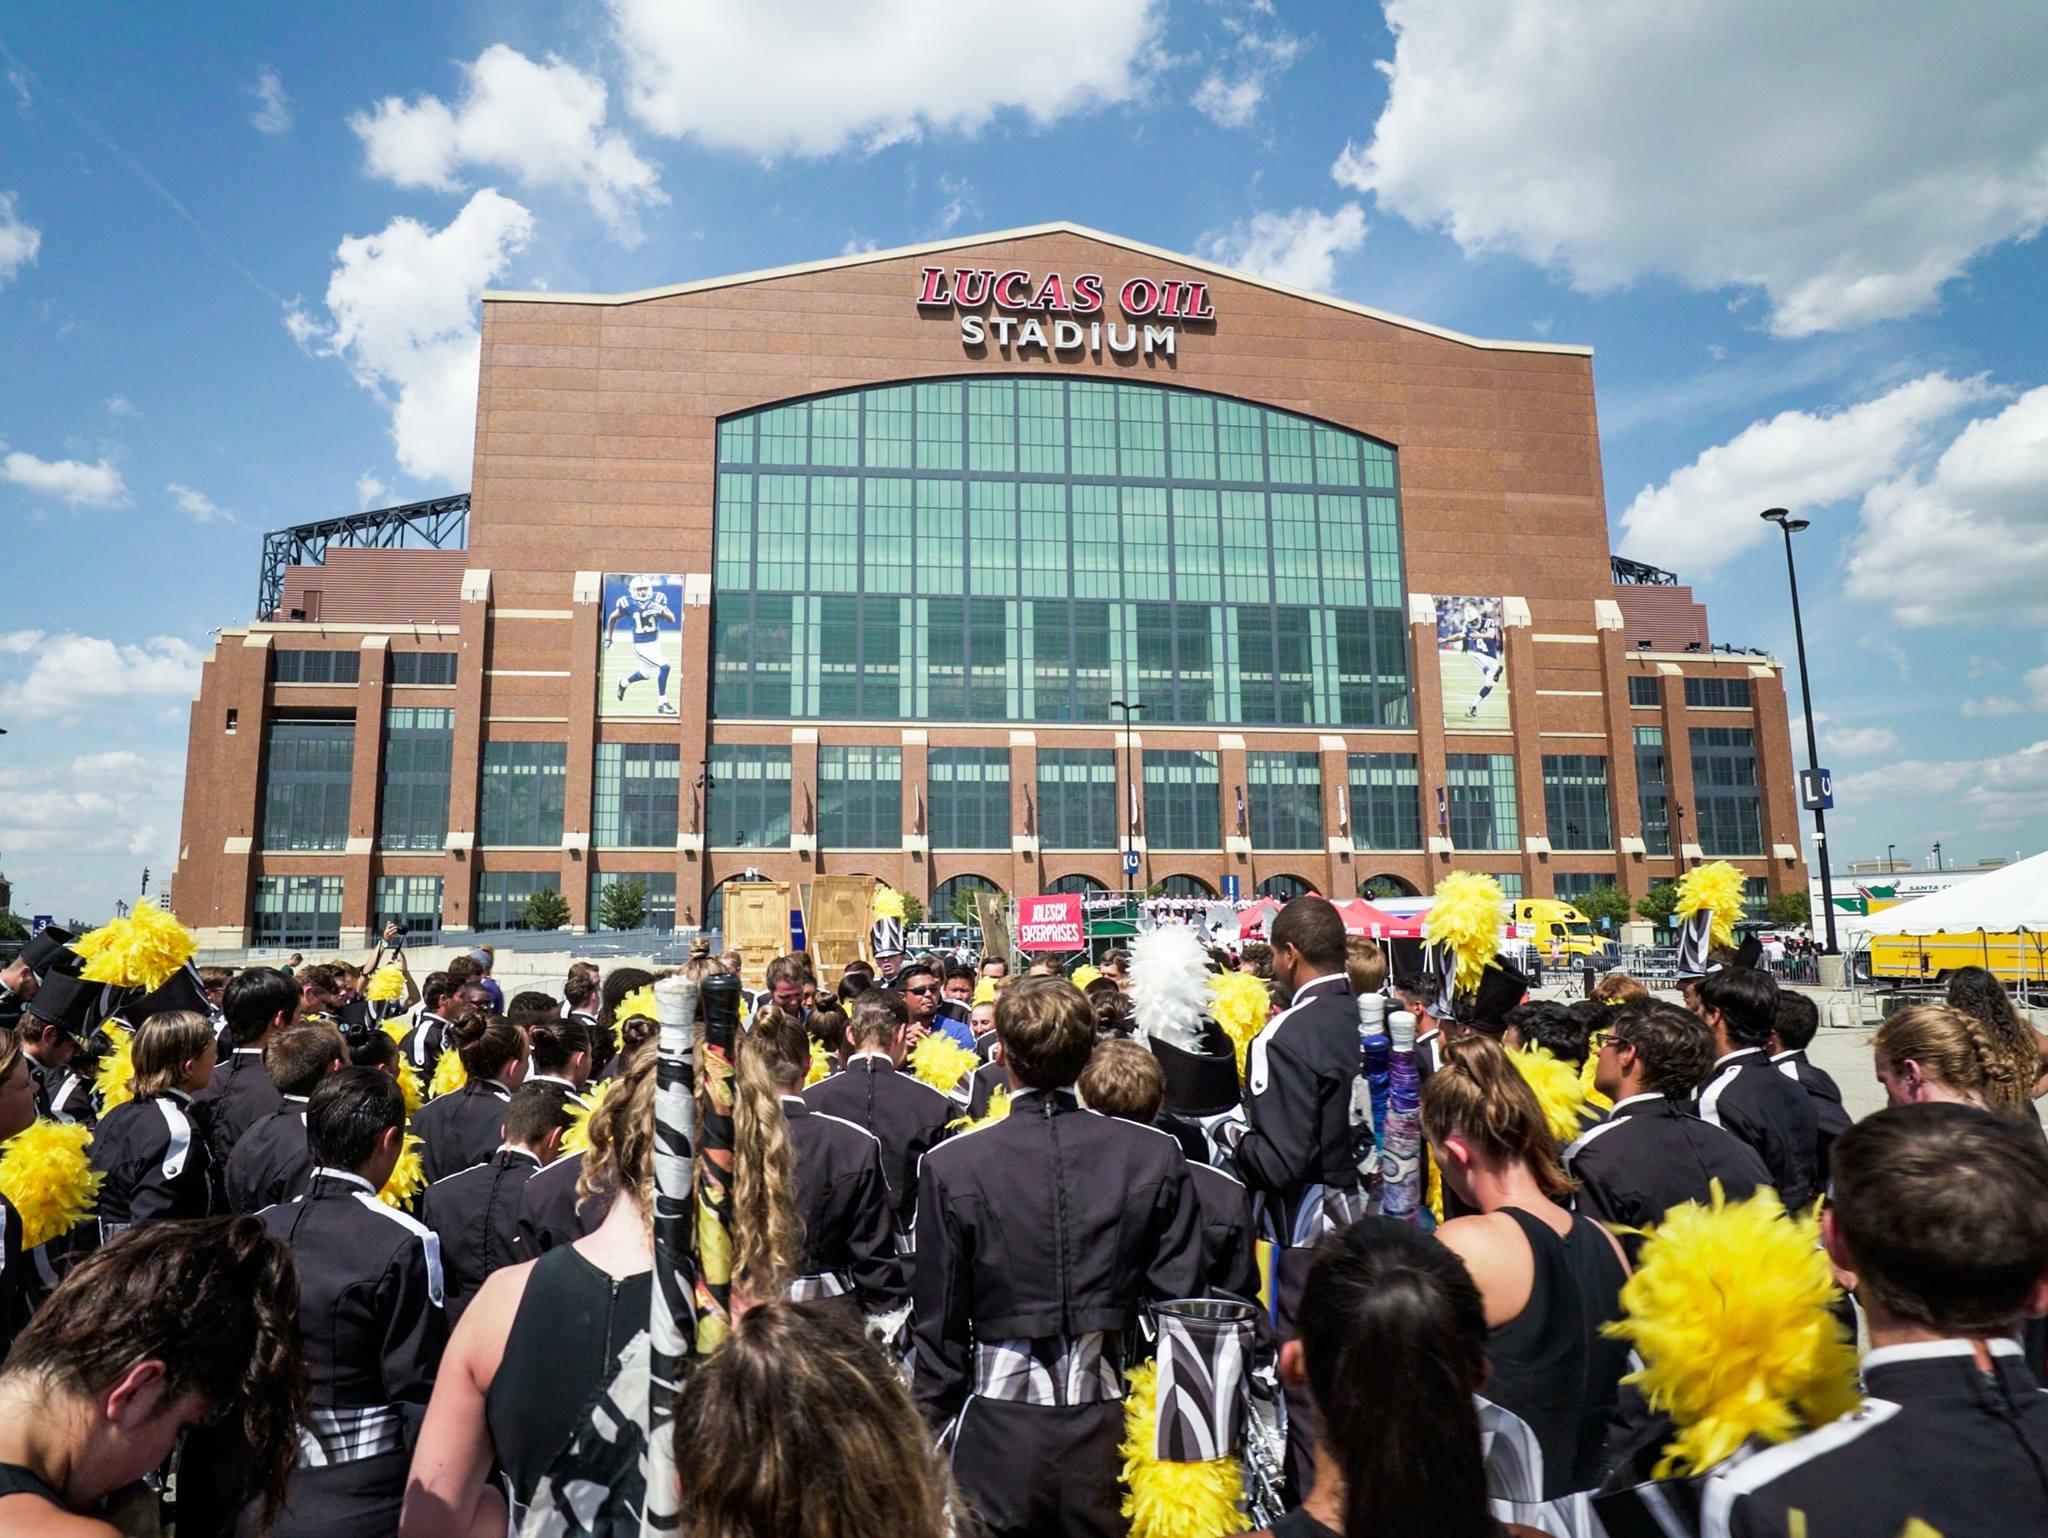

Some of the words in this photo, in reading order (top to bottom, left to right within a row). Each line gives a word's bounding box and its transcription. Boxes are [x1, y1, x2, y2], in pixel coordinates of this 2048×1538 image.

[917, 266, 1103, 313] LUCAS
[1119, 277, 1215, 320] OIL
[961, 315, 1175, 355] STADIUM
[1804, 776, 1819, 802] L
[1031, 902, 1067, 922] JOLESCH
[38, 919, 47, 930] 3
[1021, 923, 1079, 943] ENTERPRISES
